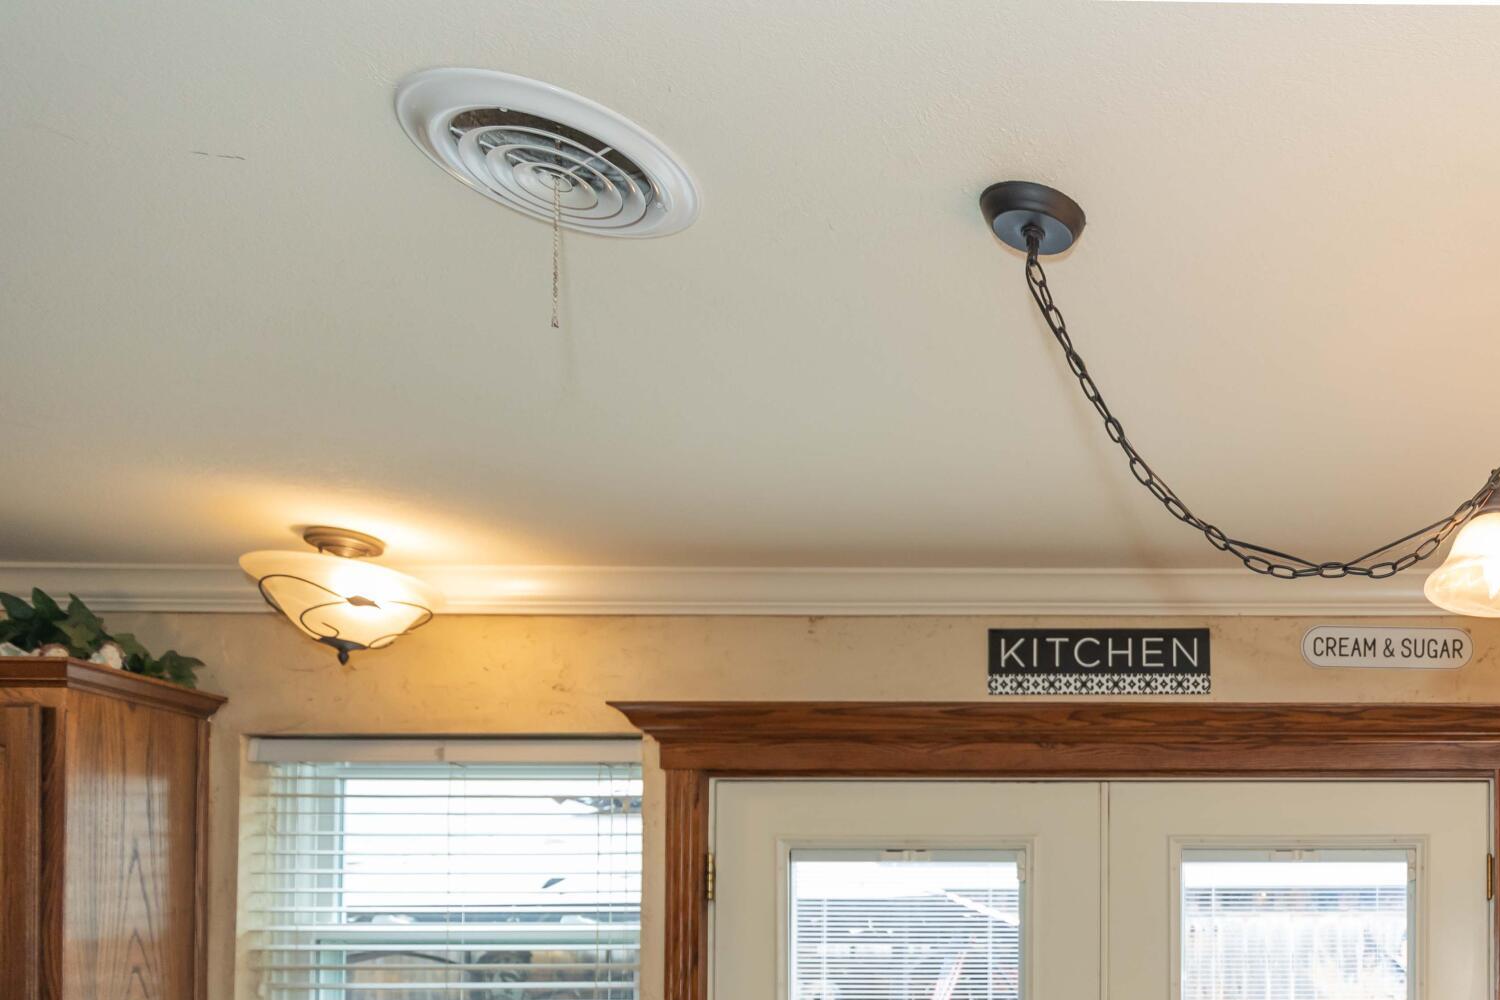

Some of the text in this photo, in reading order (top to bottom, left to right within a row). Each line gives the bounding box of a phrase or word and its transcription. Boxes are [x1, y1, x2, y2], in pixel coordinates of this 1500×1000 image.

[1000, 637, 1199, 668] KITCHEN
[1312, 636, 1465, 659] CREAM & SUGAR
